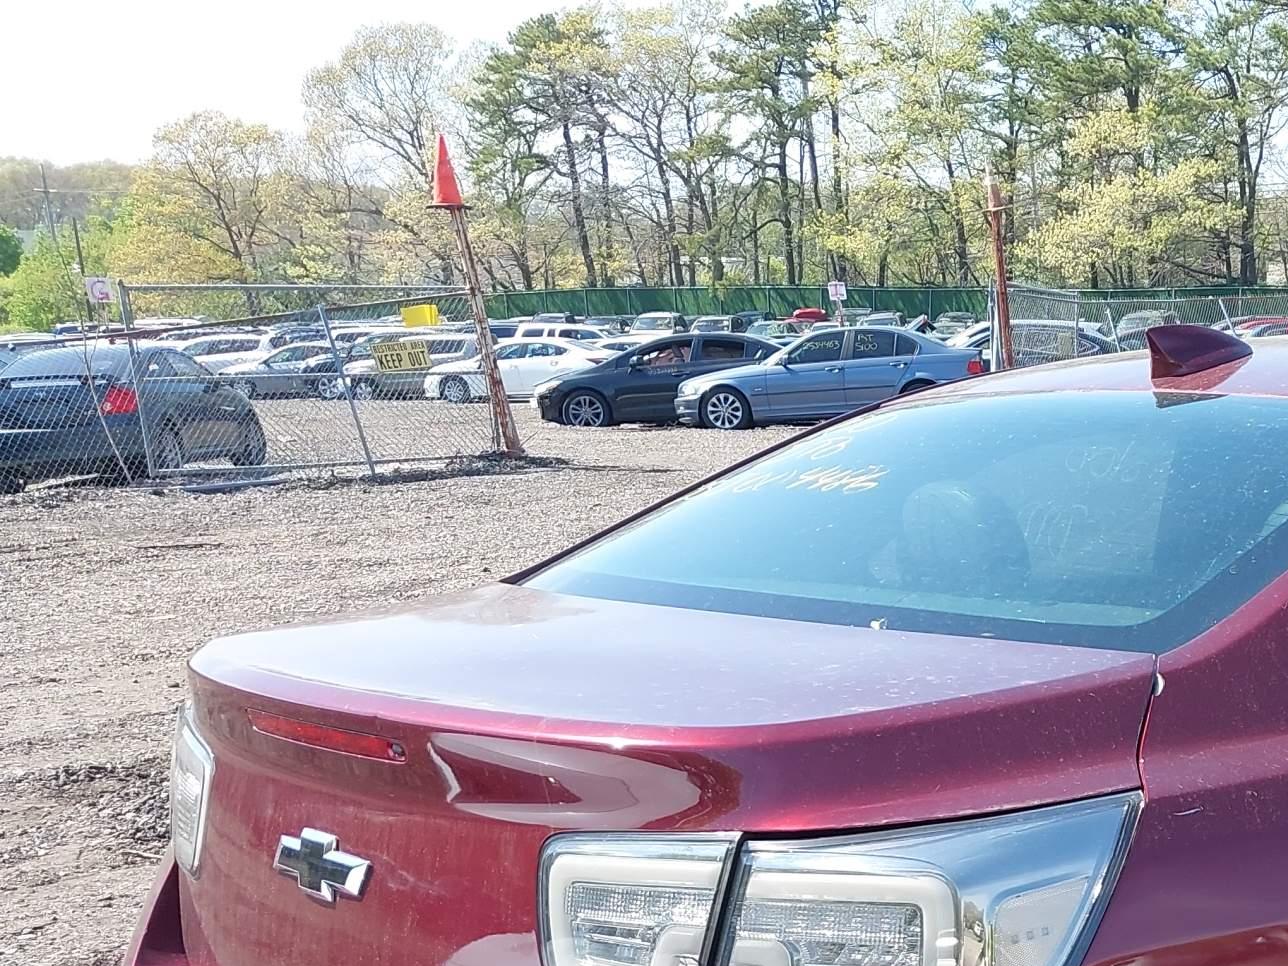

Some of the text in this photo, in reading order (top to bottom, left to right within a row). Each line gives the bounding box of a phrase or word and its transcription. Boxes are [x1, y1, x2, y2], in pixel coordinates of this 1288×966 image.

[372, 340, 426, 354] RESTRICTED AREA
[376, 350, 429, 371] KEEP OUT
